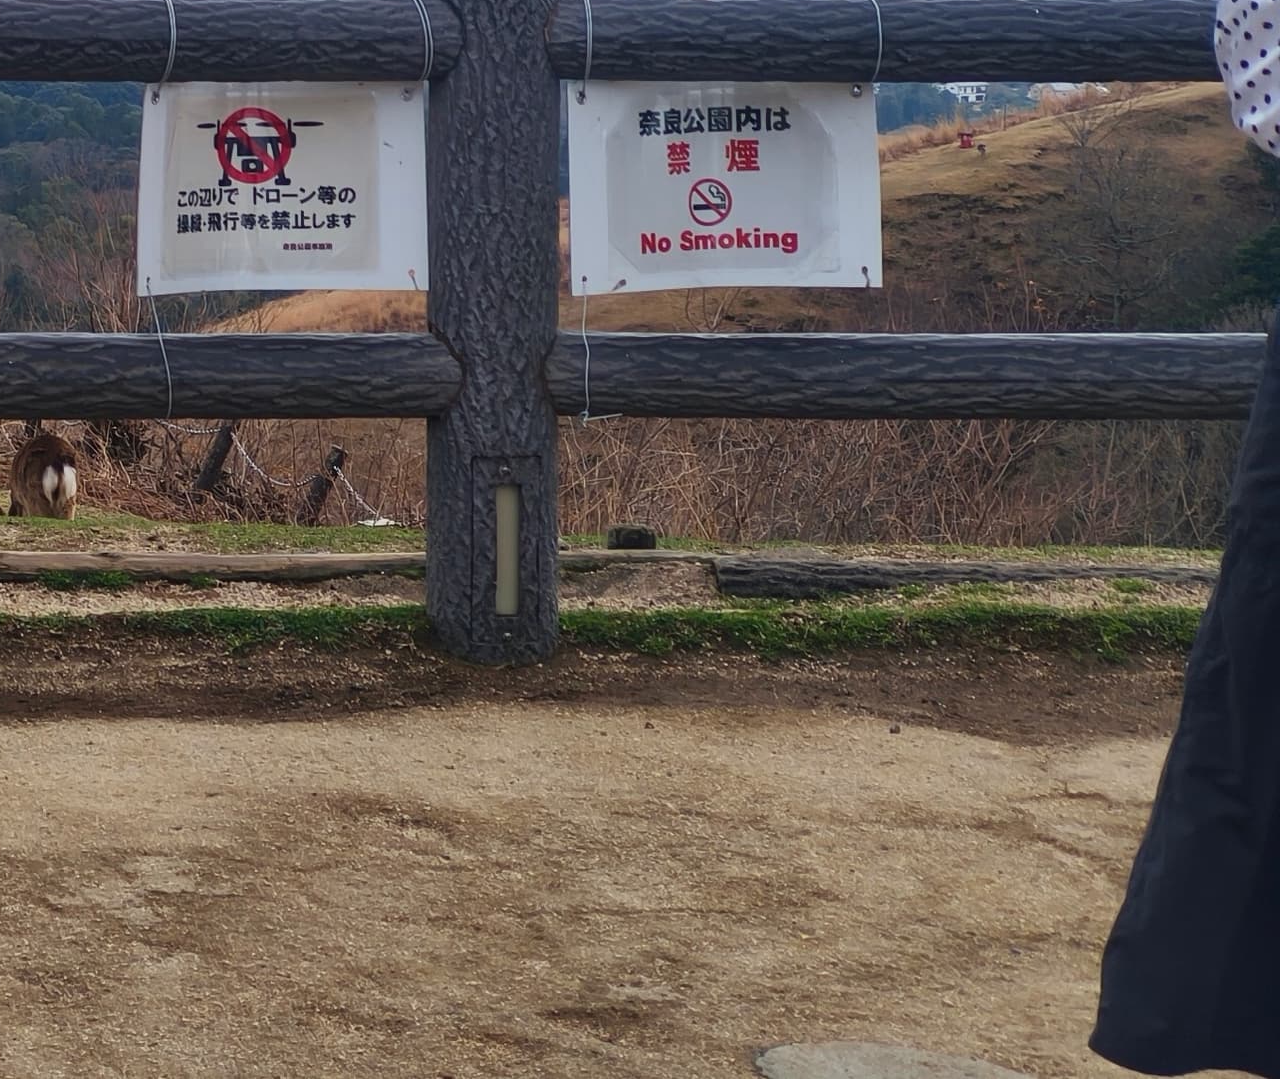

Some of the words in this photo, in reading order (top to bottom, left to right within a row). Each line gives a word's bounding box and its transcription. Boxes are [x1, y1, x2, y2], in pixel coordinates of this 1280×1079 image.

[639, 105, 792, 136] 奈良公園内は
[177, 187, 239, 207] この辺りで
[252, 186, 356, 205] ドローン等の
[641, 232, 671, 254] No
[680, 228, 798, 254] Smoking
